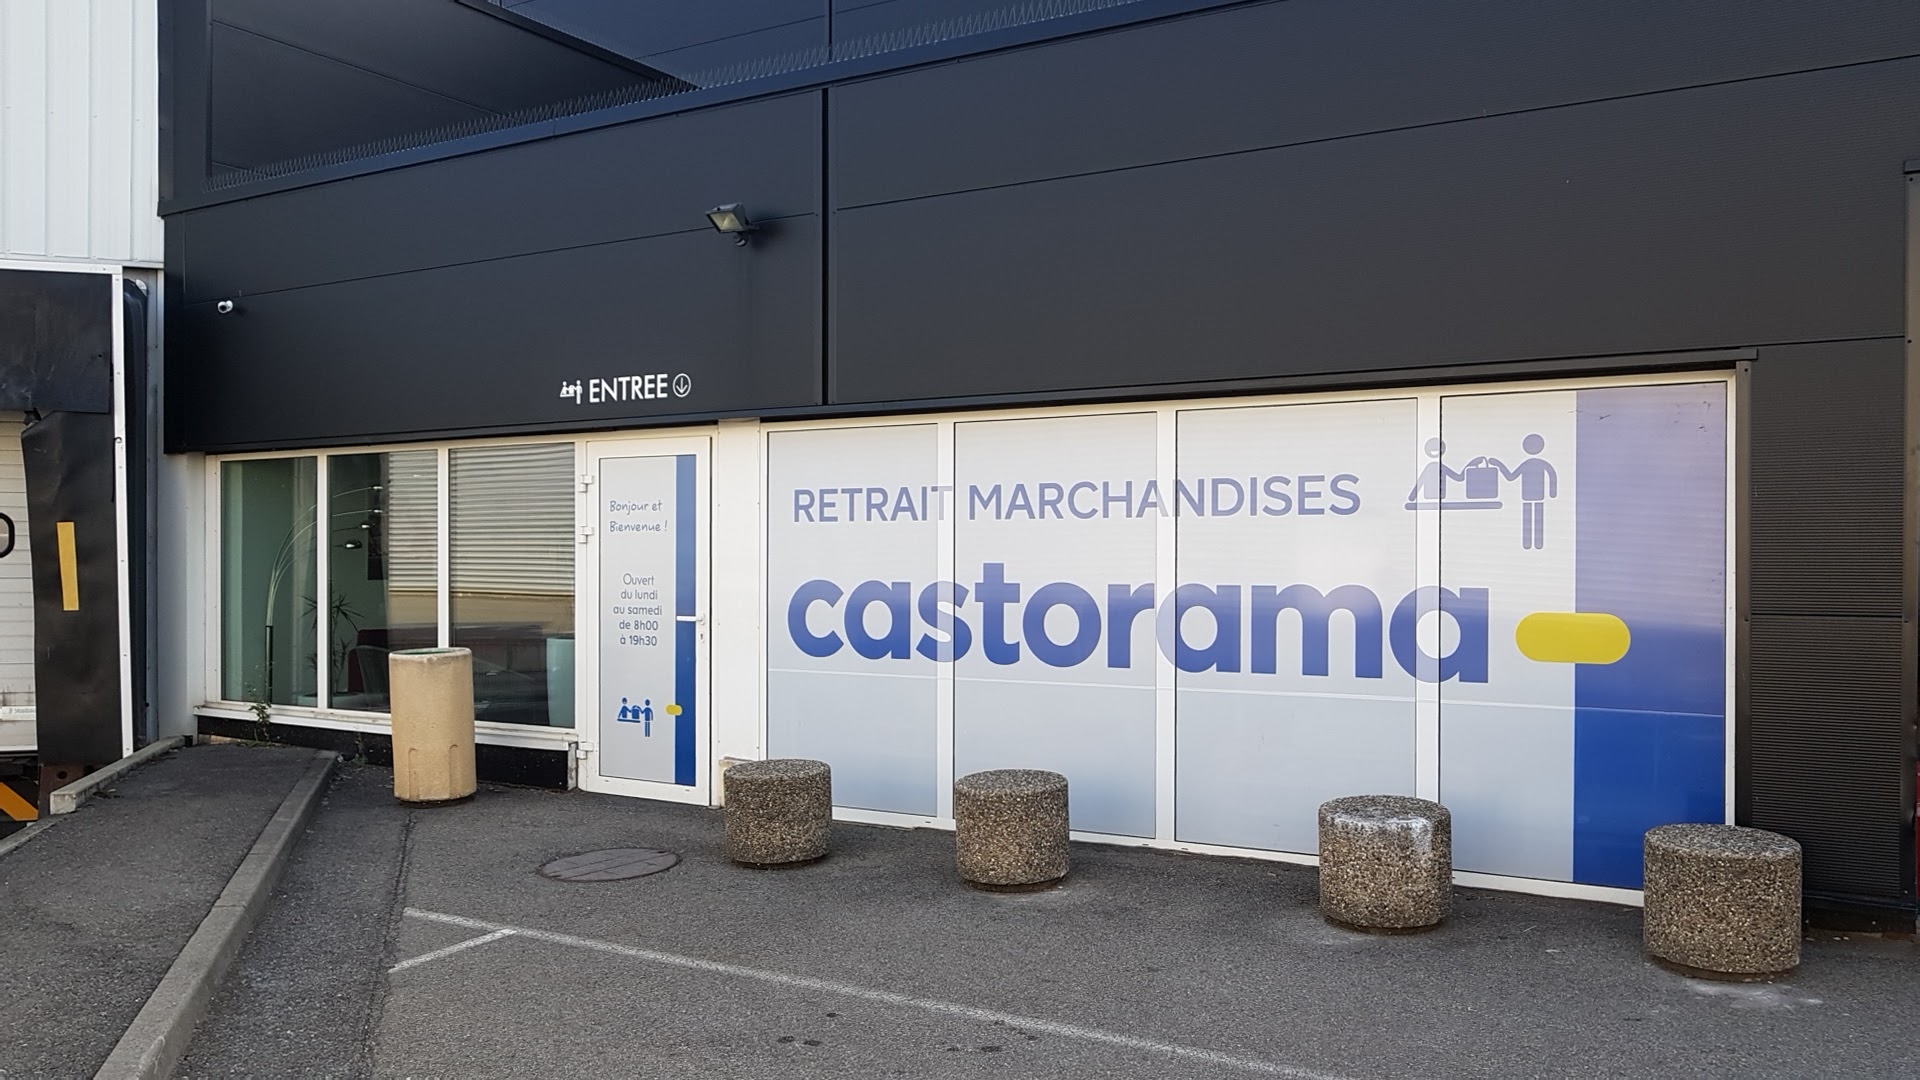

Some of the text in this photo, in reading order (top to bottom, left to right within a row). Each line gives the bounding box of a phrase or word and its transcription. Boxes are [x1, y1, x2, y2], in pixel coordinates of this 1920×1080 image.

[589, 373, 668, 403] ENTREE
[793, 474, 1361, 523] RETRAIT MARCHANDISES
[610, 499, 663, 515] Bonjour et
[609, 520, 661, 532] Bienvenue
[622, 572, 655, 586] Ouvert
[620, 588, 658, 600] du lundi
[613, 604, 663, 616] au samedi
[618, 620, 659, 631] de 8h00
[787, 562, 1489, 683] castorama
[619, 634, 658, 647] à 19h30
